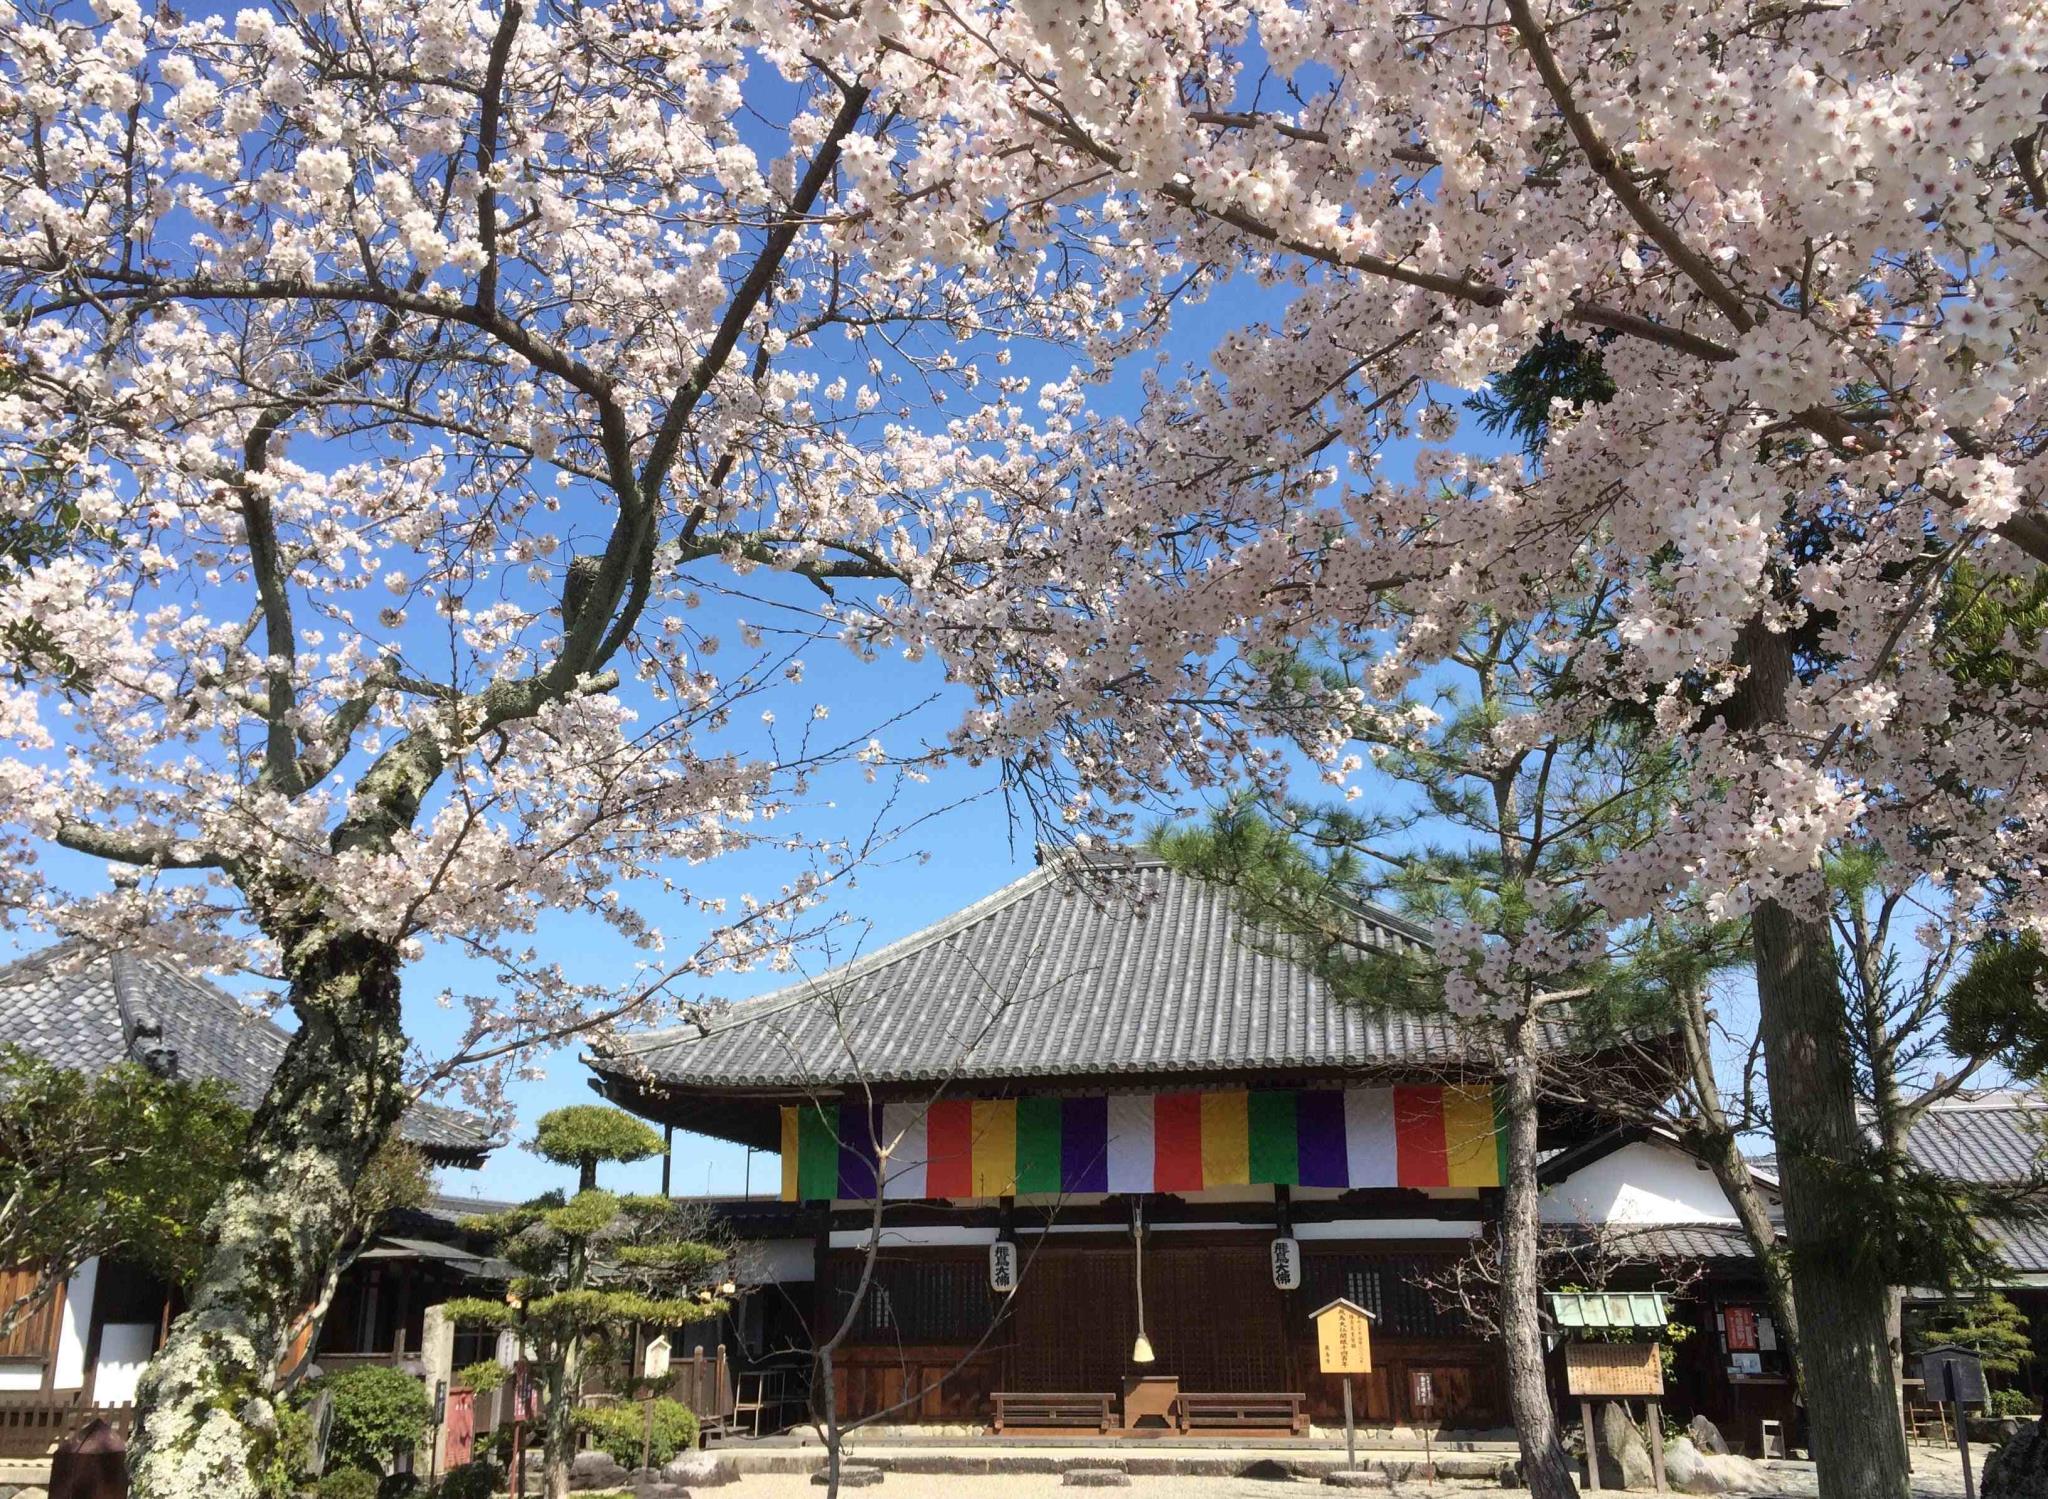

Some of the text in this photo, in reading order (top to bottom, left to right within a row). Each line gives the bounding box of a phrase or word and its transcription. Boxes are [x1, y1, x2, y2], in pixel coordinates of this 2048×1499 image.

[995, 1246, 1009, 1287] 飛鳥大佛
[1274, 1242, 1290, 1285] 飛鳥大佛
